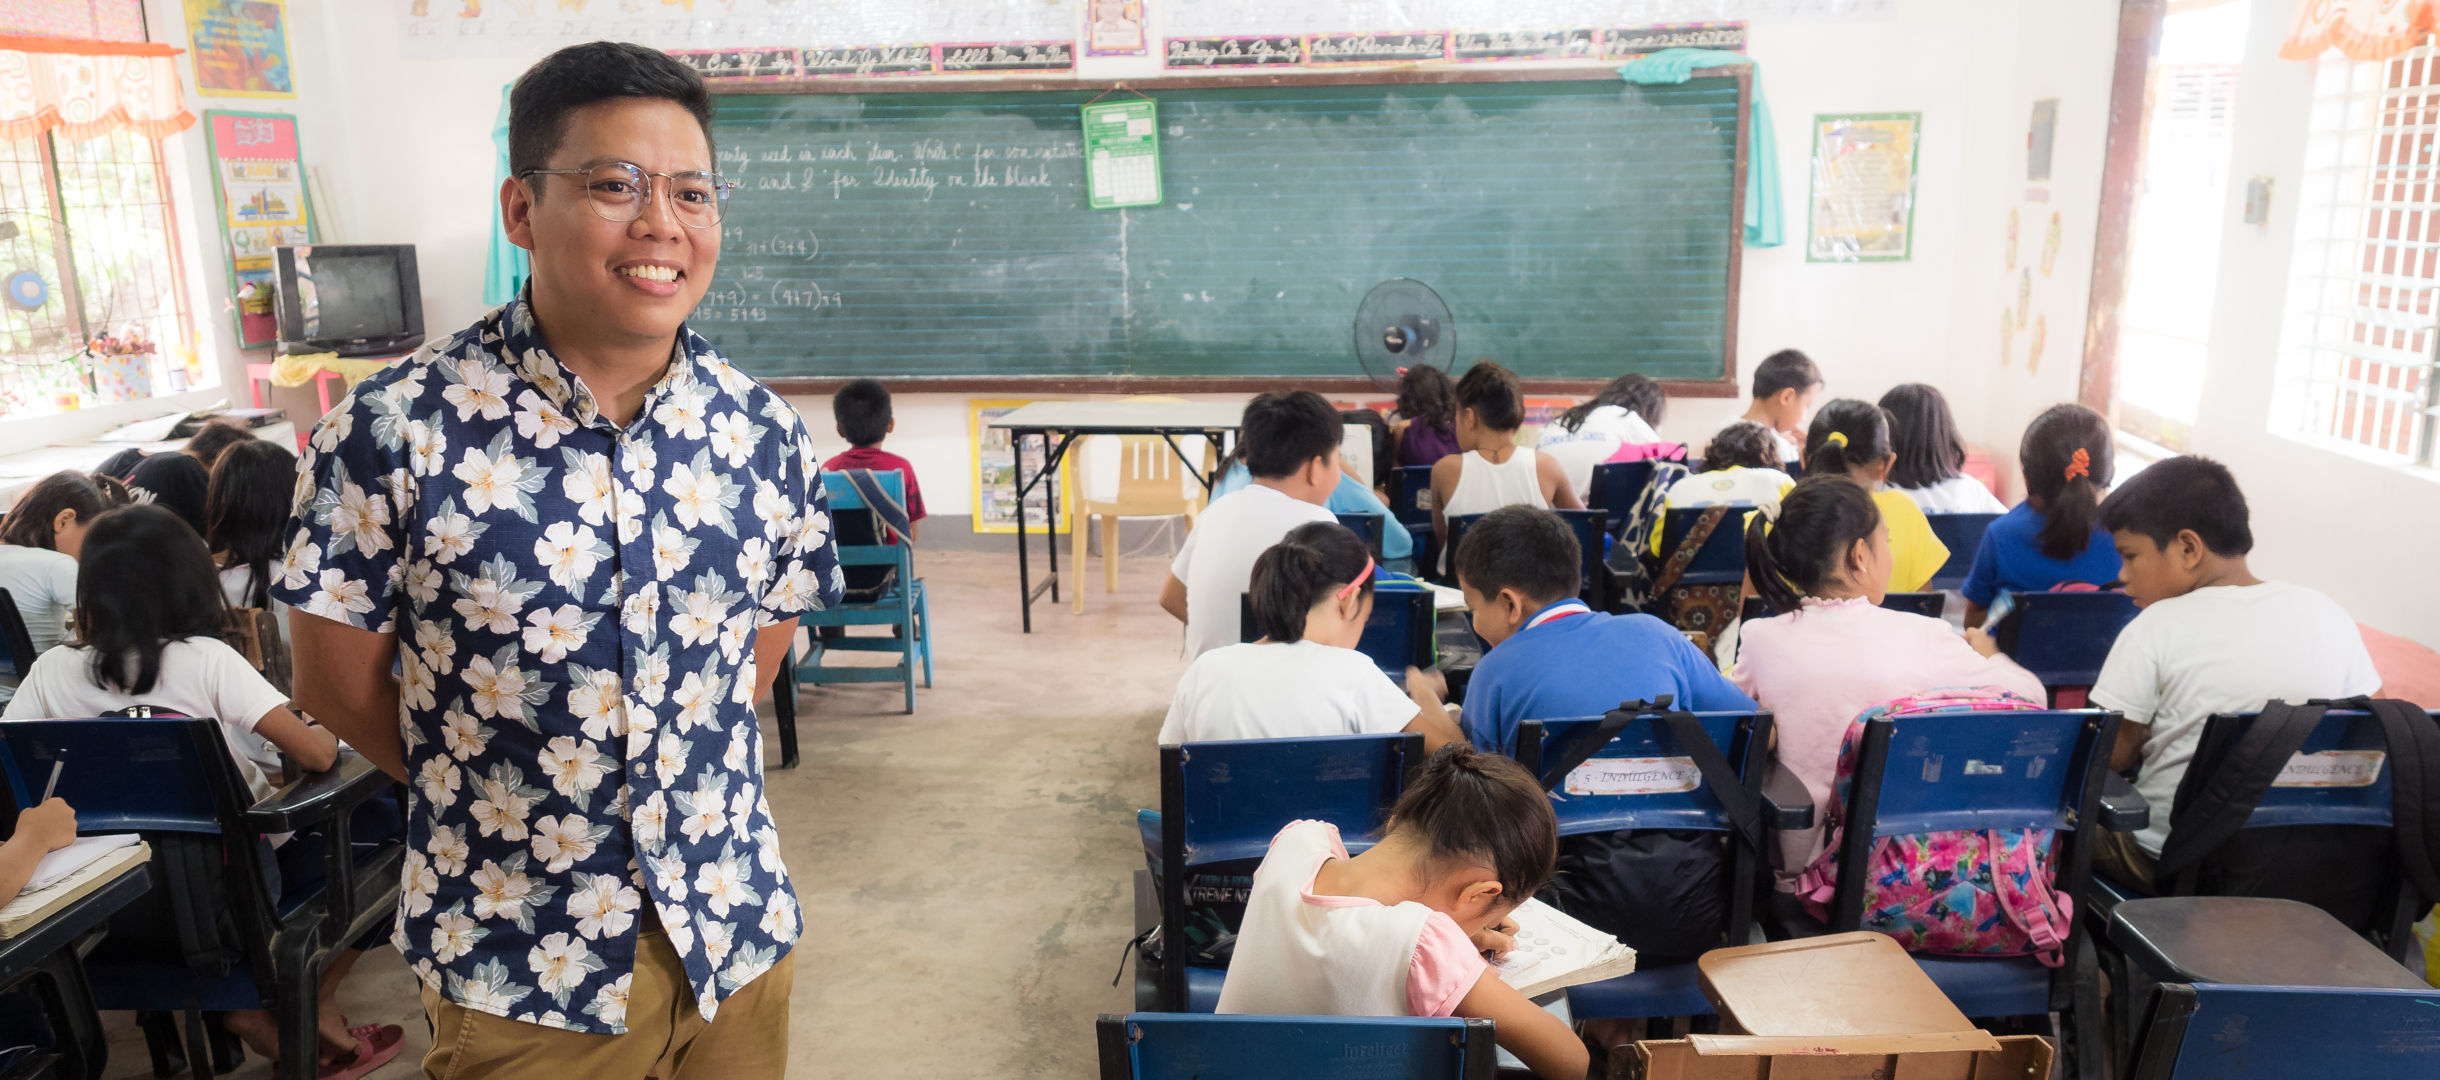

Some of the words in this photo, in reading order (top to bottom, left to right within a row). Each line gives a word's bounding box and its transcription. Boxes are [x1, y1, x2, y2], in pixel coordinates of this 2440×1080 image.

[758, 171, 796, 191] and
[830, 169, 861, 199] for
[948, 173, 968, 187] on
[1600, 770, 1686, 783] INDULGENCE
[2282, 764, 2365, 777] NDULGENCE
